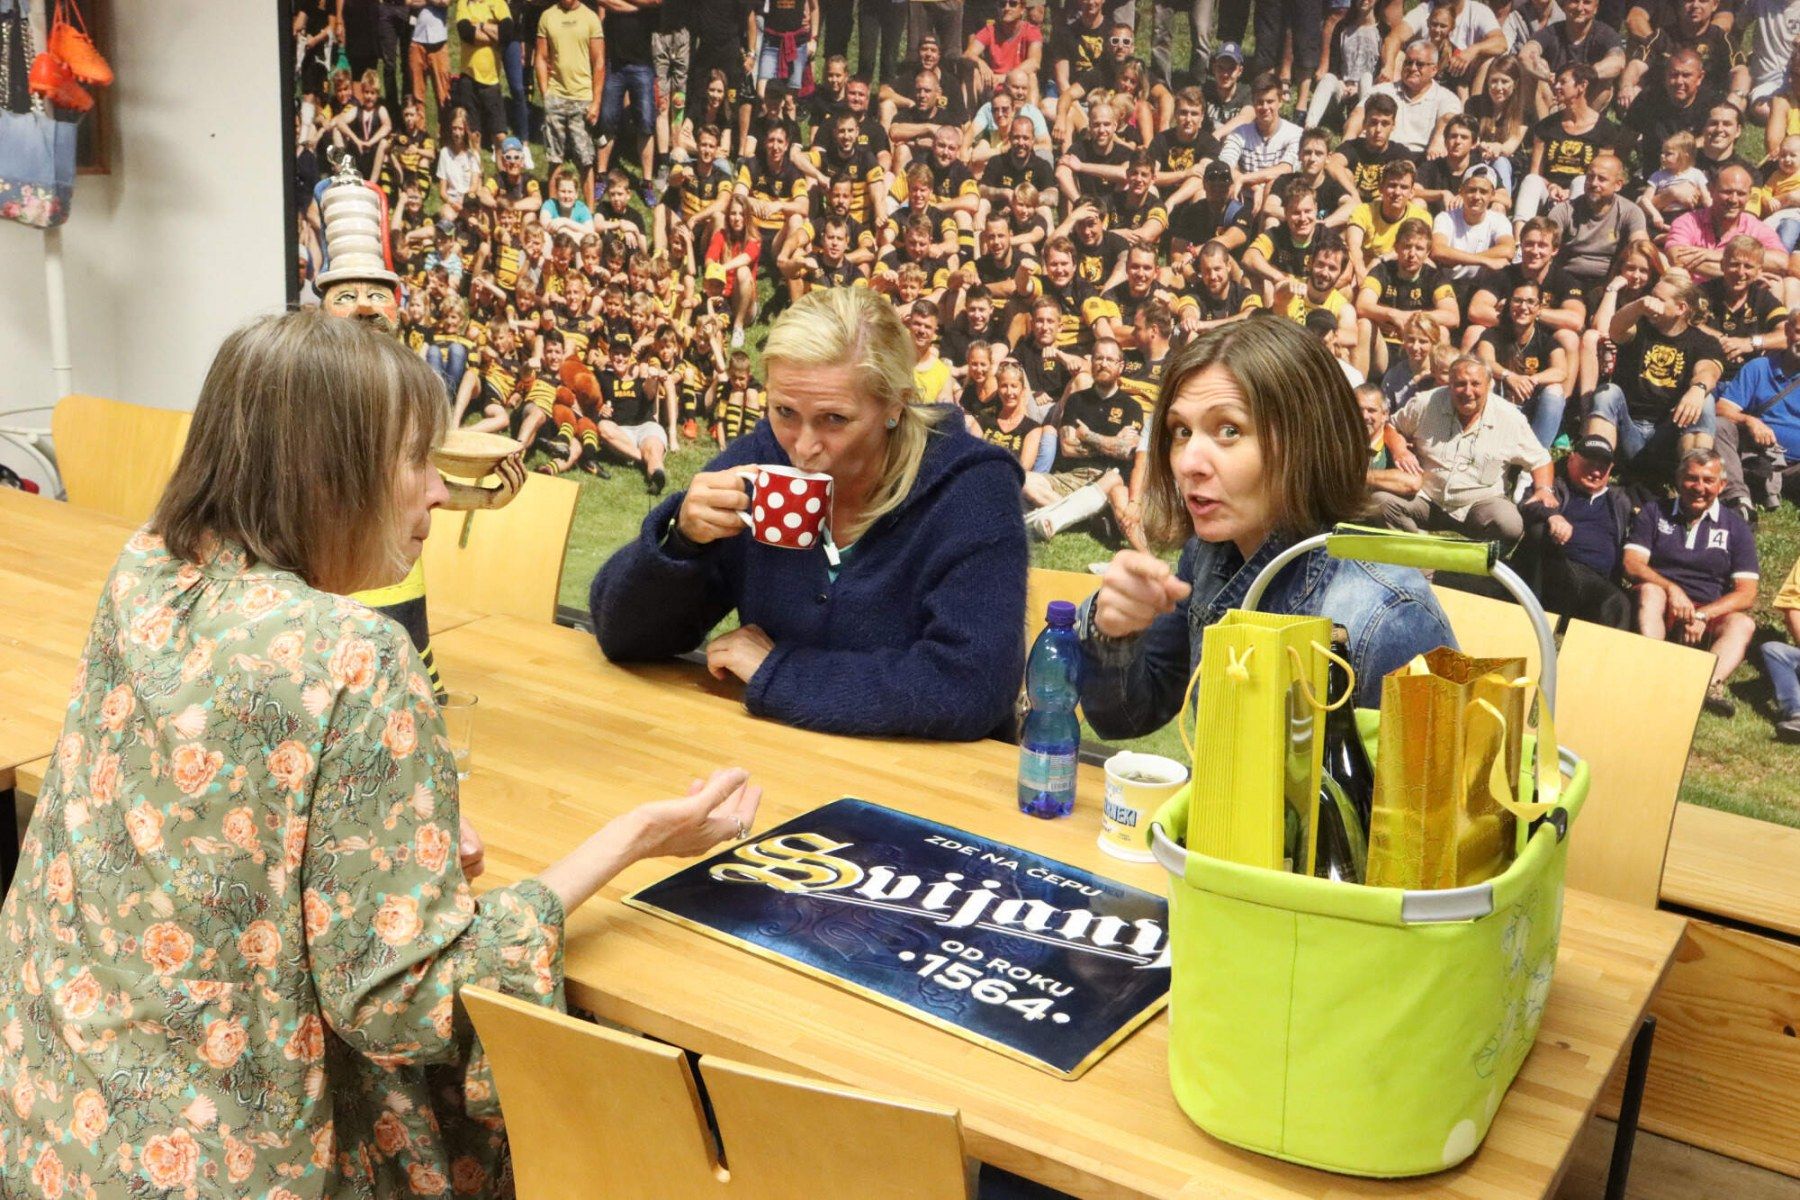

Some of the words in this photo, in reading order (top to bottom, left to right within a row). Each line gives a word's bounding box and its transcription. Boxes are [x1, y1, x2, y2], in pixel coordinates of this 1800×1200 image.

[1713, 531, 1725, 546] 4
[924, 834, 975, 858] ZDE
[984, 851, 1019, 872] NA
[1028, 863, 1105, 899] ČEPU
[709, 832, 1171, 969] Svijany
[940, 939, 985, 963] OD
[995, 957, 1075, 999] ROKU
